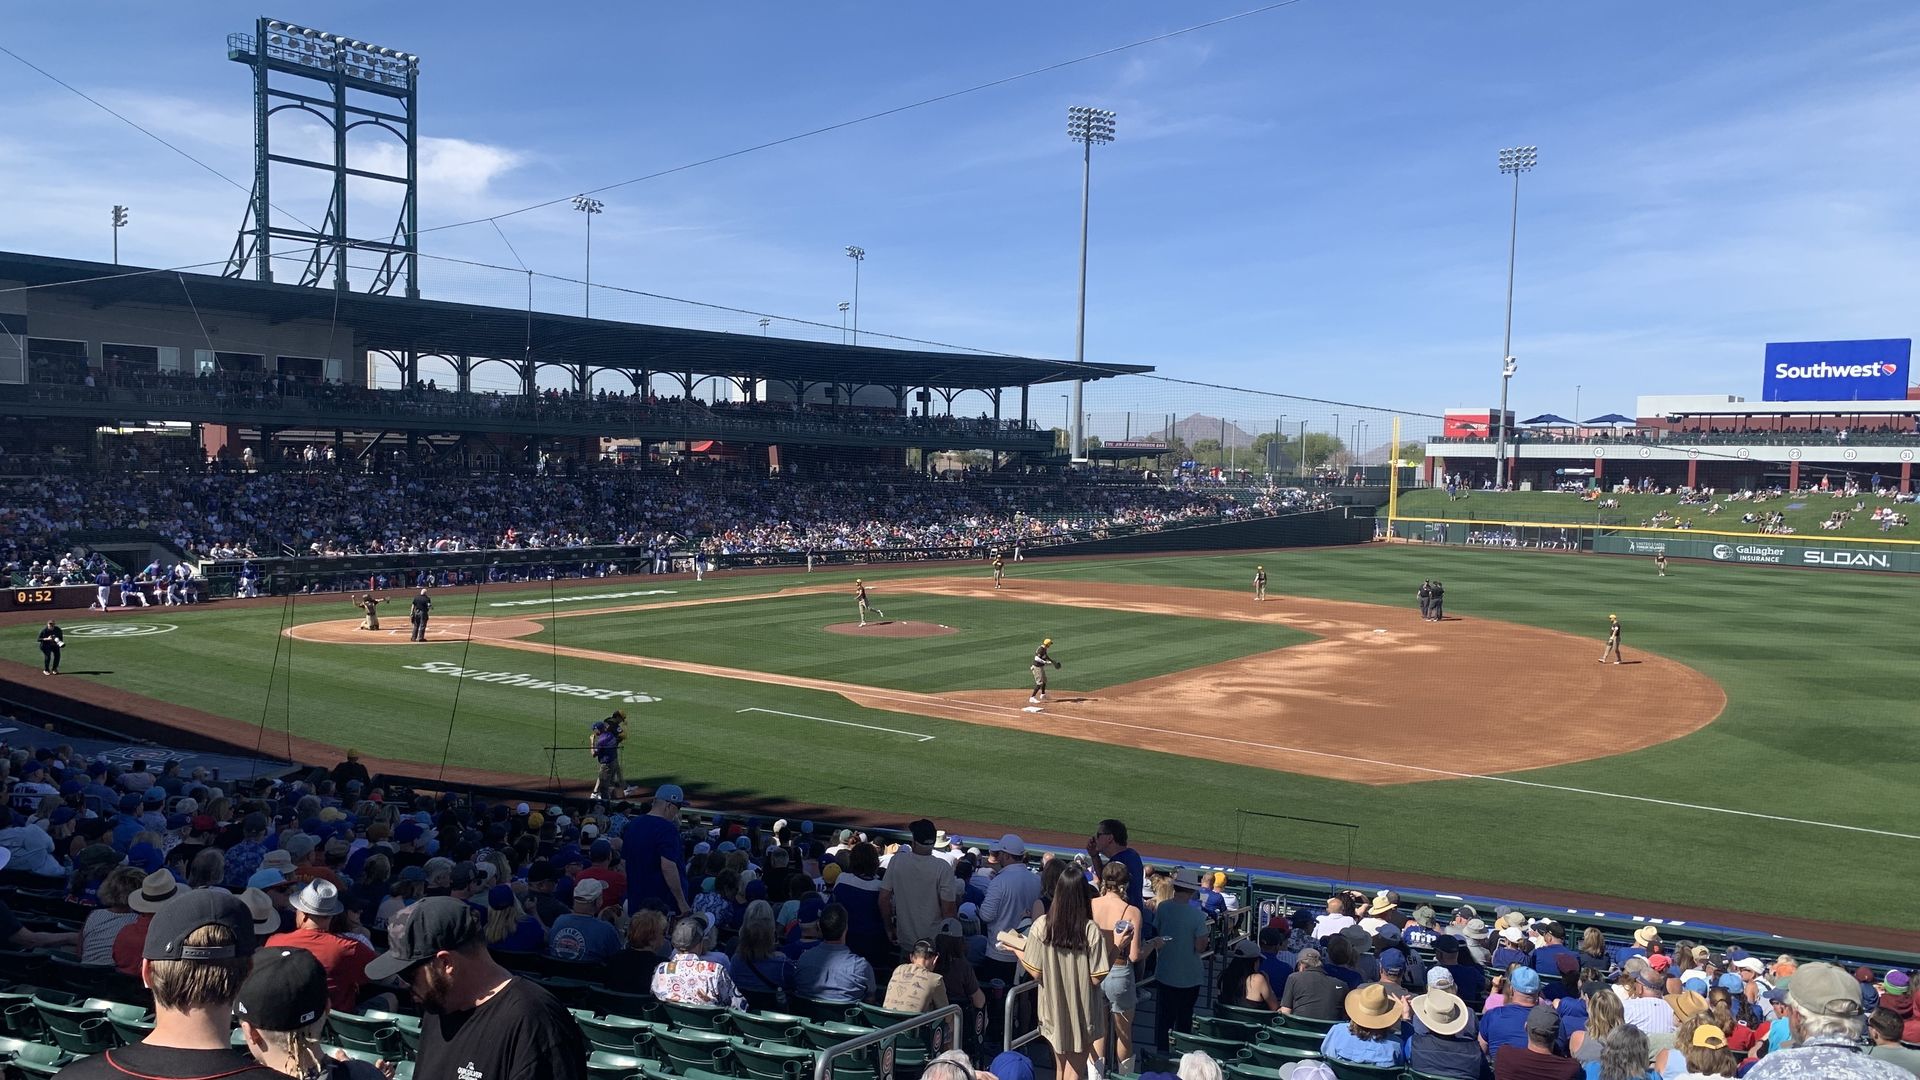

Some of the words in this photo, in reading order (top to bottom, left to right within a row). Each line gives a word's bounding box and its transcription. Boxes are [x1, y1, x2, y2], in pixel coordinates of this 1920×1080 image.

[1775, 361, 1881, 378] Southwest
[1736, 545, 1784, 556] Gallagher
[17, 590, 52, 603] 0:52
[401, 661, 633, 700] Southwest
